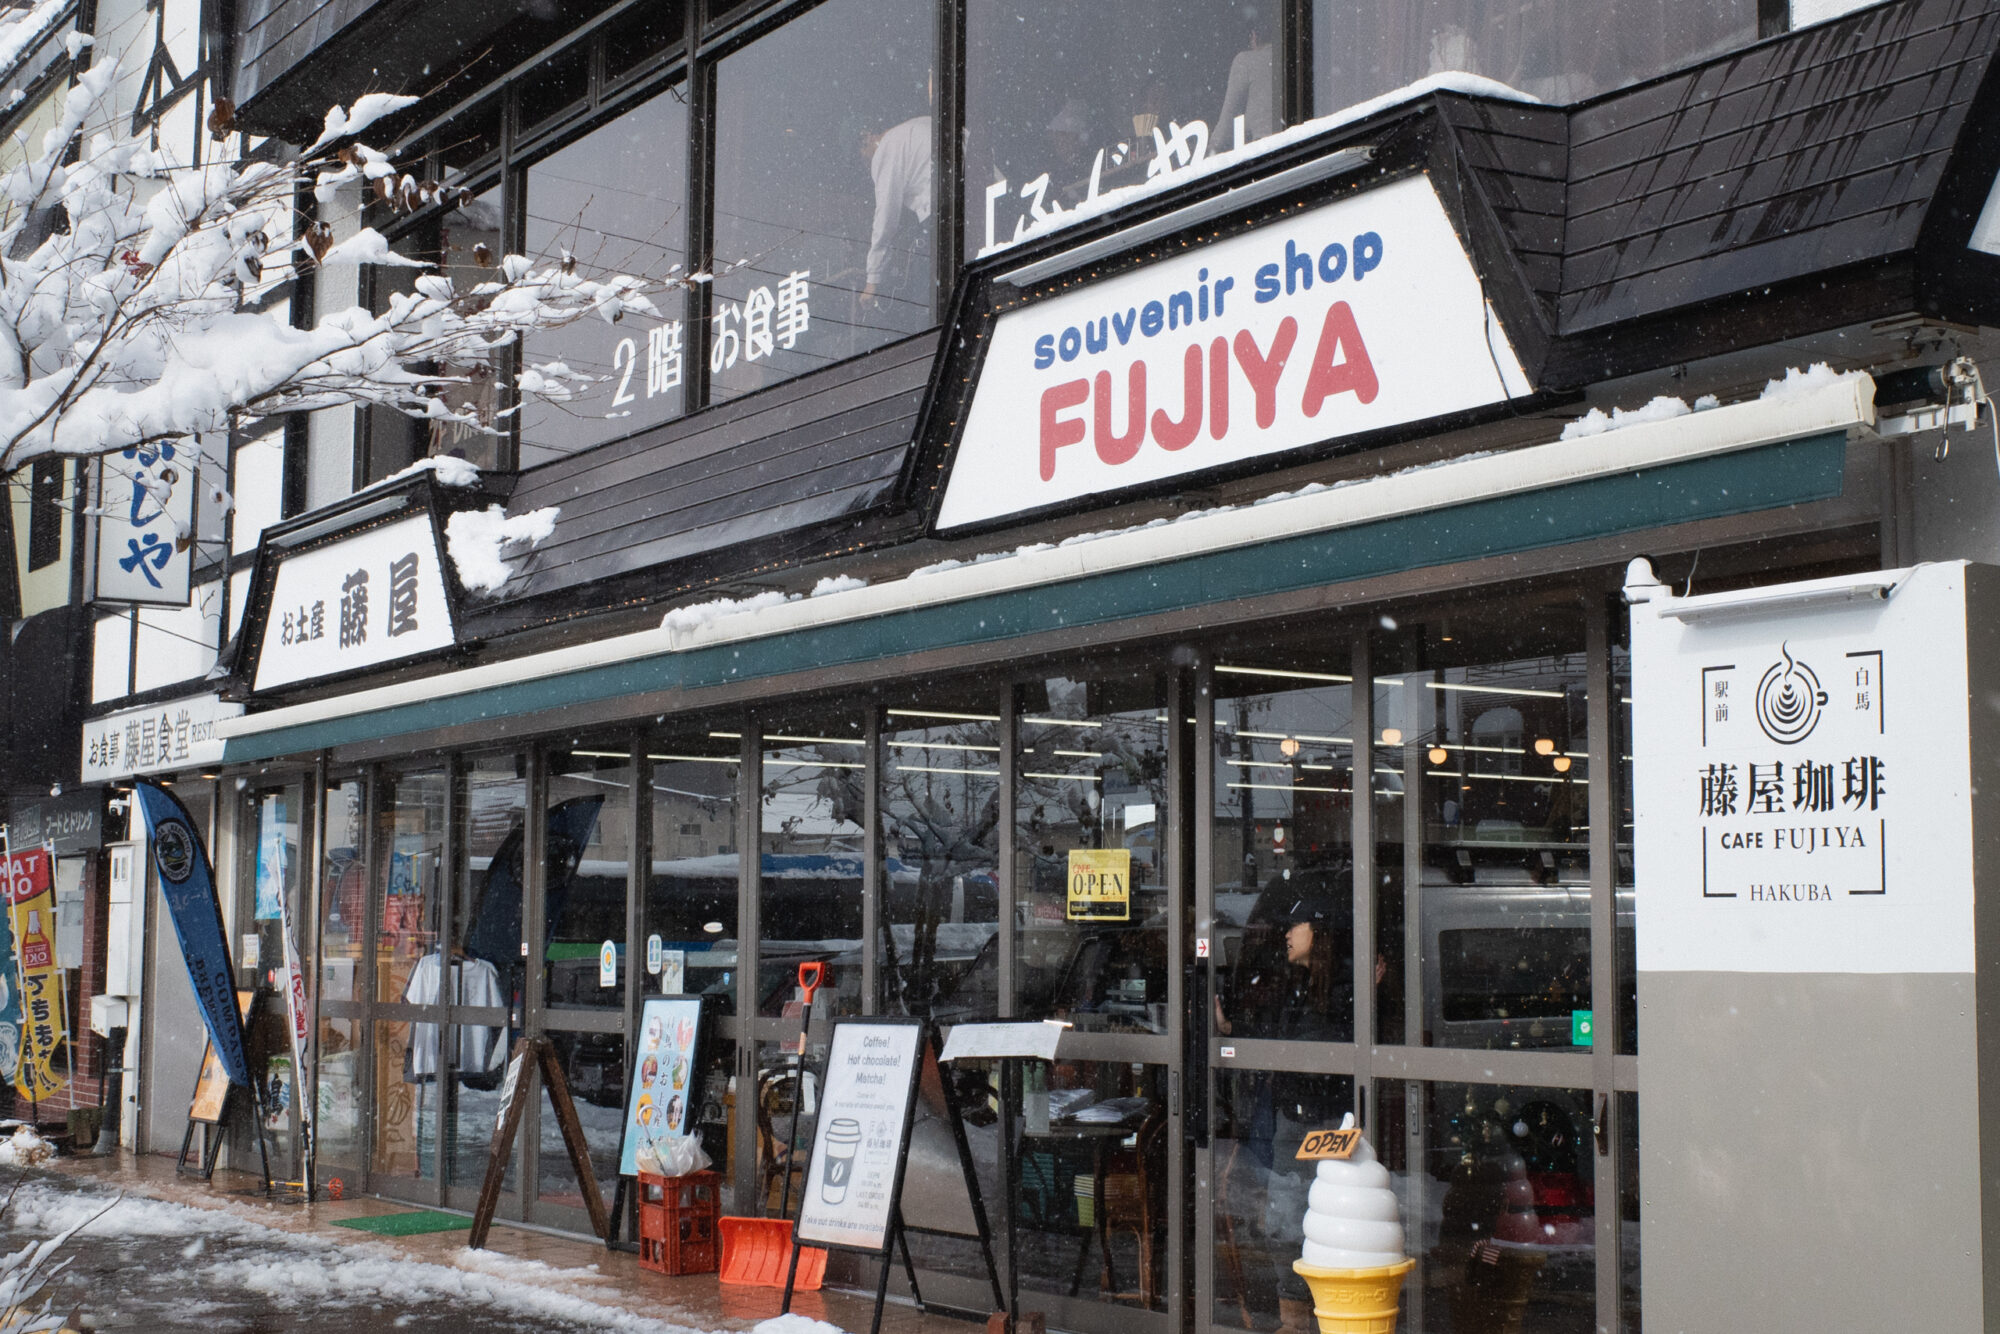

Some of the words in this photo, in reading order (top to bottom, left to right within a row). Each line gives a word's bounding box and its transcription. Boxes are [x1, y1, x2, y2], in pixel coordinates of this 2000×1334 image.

[1034, 268, 1234, 370] souvenir
[1254, 231, 1384, 303] shop
[1039, 300, 1379, 482] FUJIYA
[281, 600, 324, 646] お土産
[340, 552, 420, 650] 藤屋
[1714, 680, 1729, 722] 駅前
[1855, 666, 1870, 711] 白馬
[89, 730, 120, 769] お食事
[123, 709, 191, 772] 藤屋食堂
[1699, 756, 1886, 817] 藤屋珈琲
[1721, 832, 1763, 849] CAFE
[1774, 826, 1866, 854] FUJIYA
[1750, 884, 1832, 901] HAKUBA
[847, 1054, 861, 1065] Hot
[862, 1054, 901, 1067] chocolate!
[863, 1036, 890, 1048] Coffee!
[855, 1072, 886, 1085] Matcha!
[1304, 1131, 1356, 1155] OPEN
